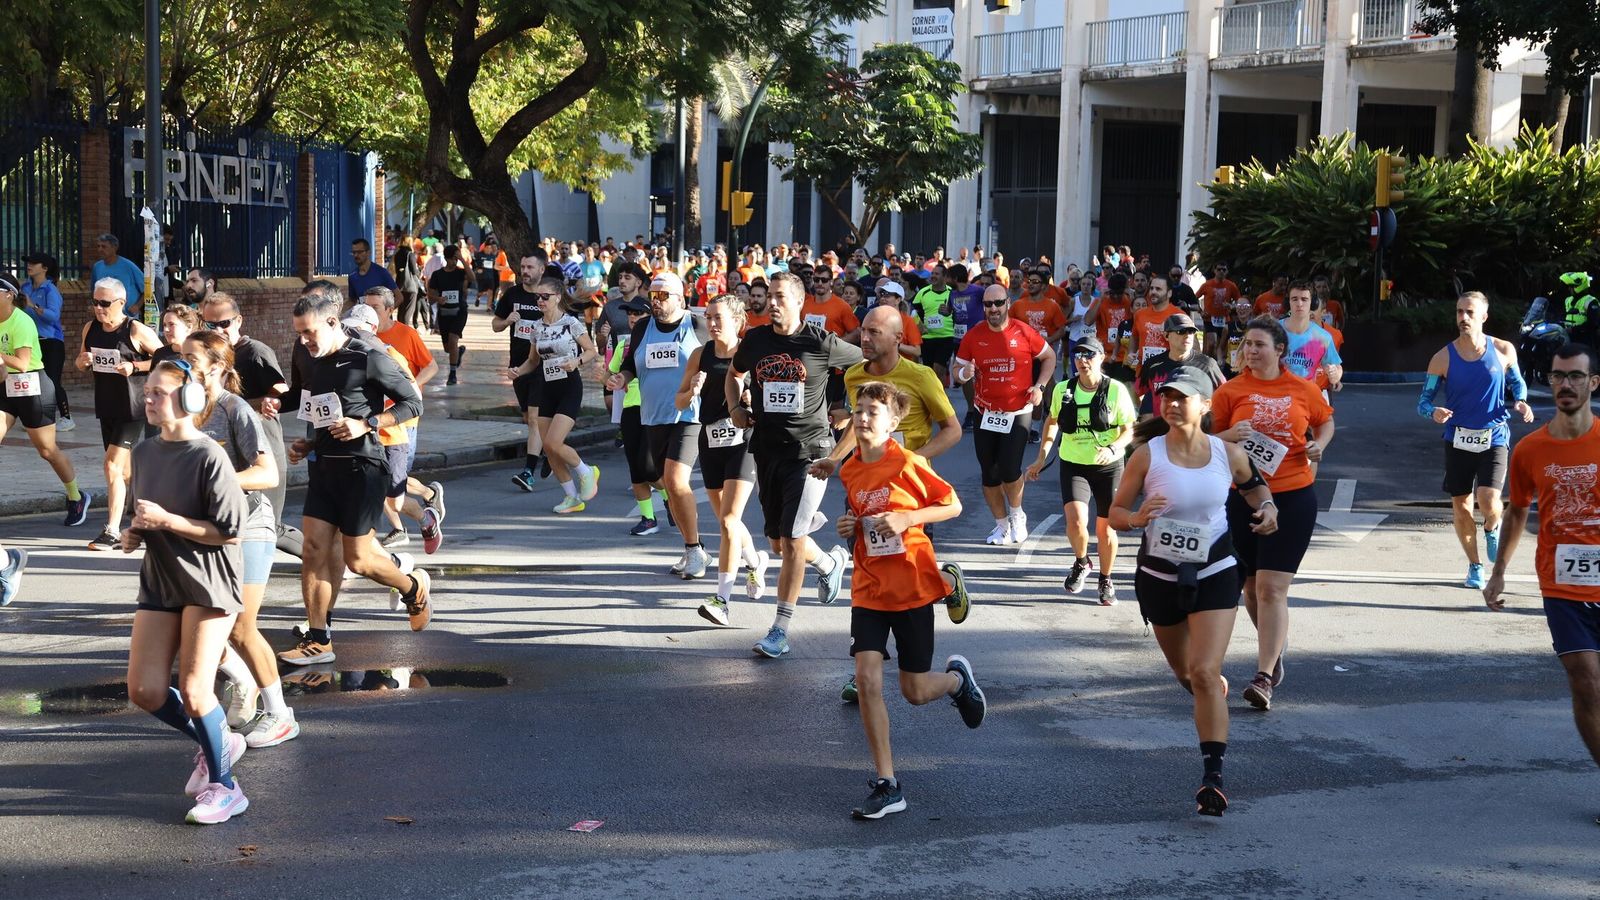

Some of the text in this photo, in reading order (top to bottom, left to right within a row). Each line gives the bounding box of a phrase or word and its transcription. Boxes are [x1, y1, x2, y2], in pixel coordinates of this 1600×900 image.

[912, 14, 949, 25] CORNER VIP
[912, 25, 948, 35] MALAGUISTA
[650, 350, 676, 360] 1036
[95, 356, 115, 366] 934
[1285, 358, 1314, 368] enough
[545, 365, 561, 375] 855
[13, 381, 29, 390] 56
[769, 392, 796, 404] 557
[315, 405, 331, 418] 19
[987, 416, 1008, 427] 639
[711, 427, 736, 439] 625
[1459, 436, 1489, 445] 1032
[1243, 440, 1275, 463] 323
[1160, 532, 1199, 551] 930
[1564, 558, 1600, 574] 751
